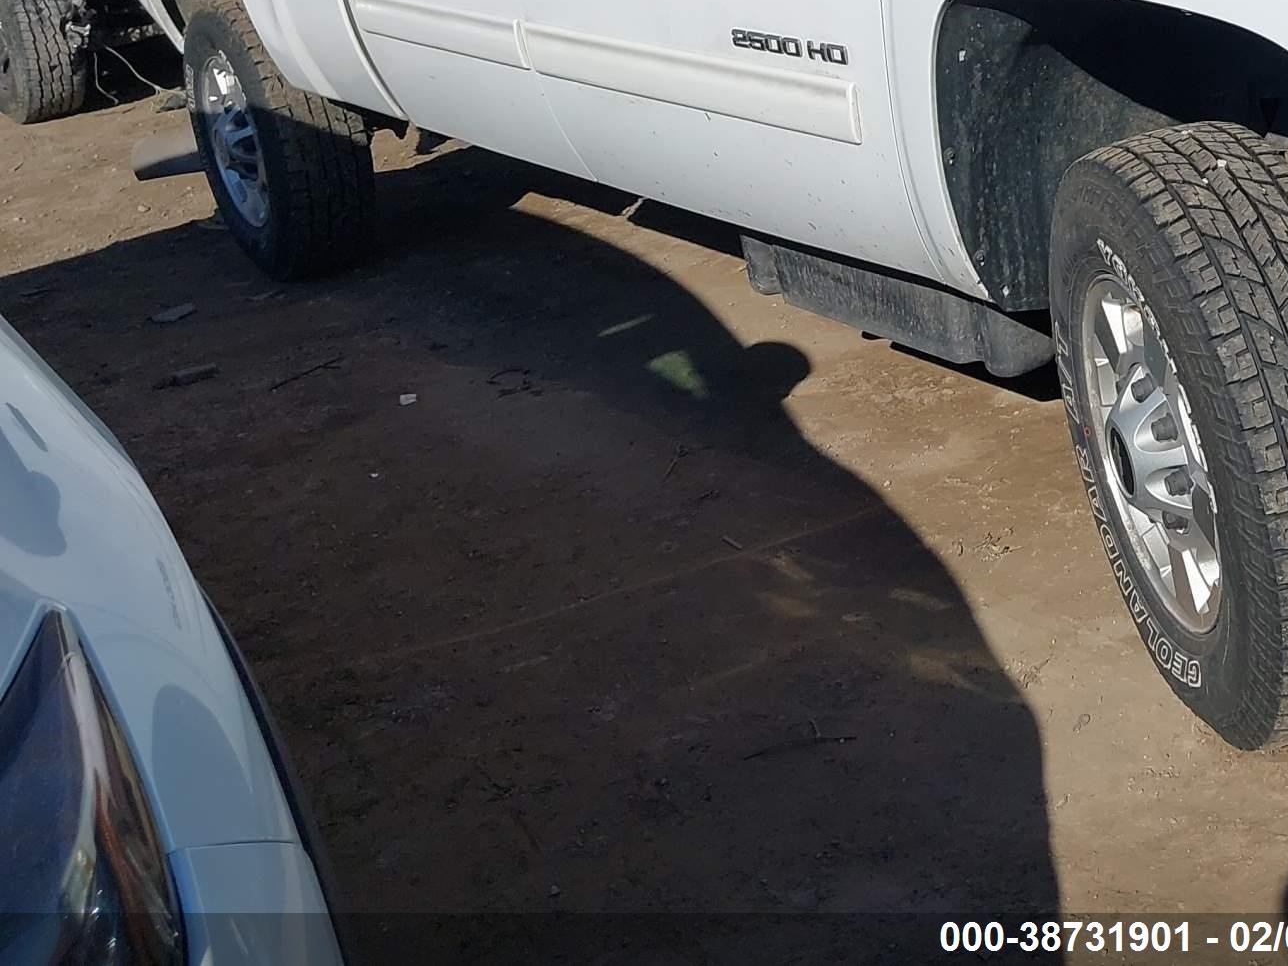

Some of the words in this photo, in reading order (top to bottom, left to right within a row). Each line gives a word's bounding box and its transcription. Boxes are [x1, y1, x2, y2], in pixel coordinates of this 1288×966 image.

[731, 28, 803, 59] 2500
[806, 39, 849, 66] HD
[1075, 444, 1202, 689] GEOLANDAR
